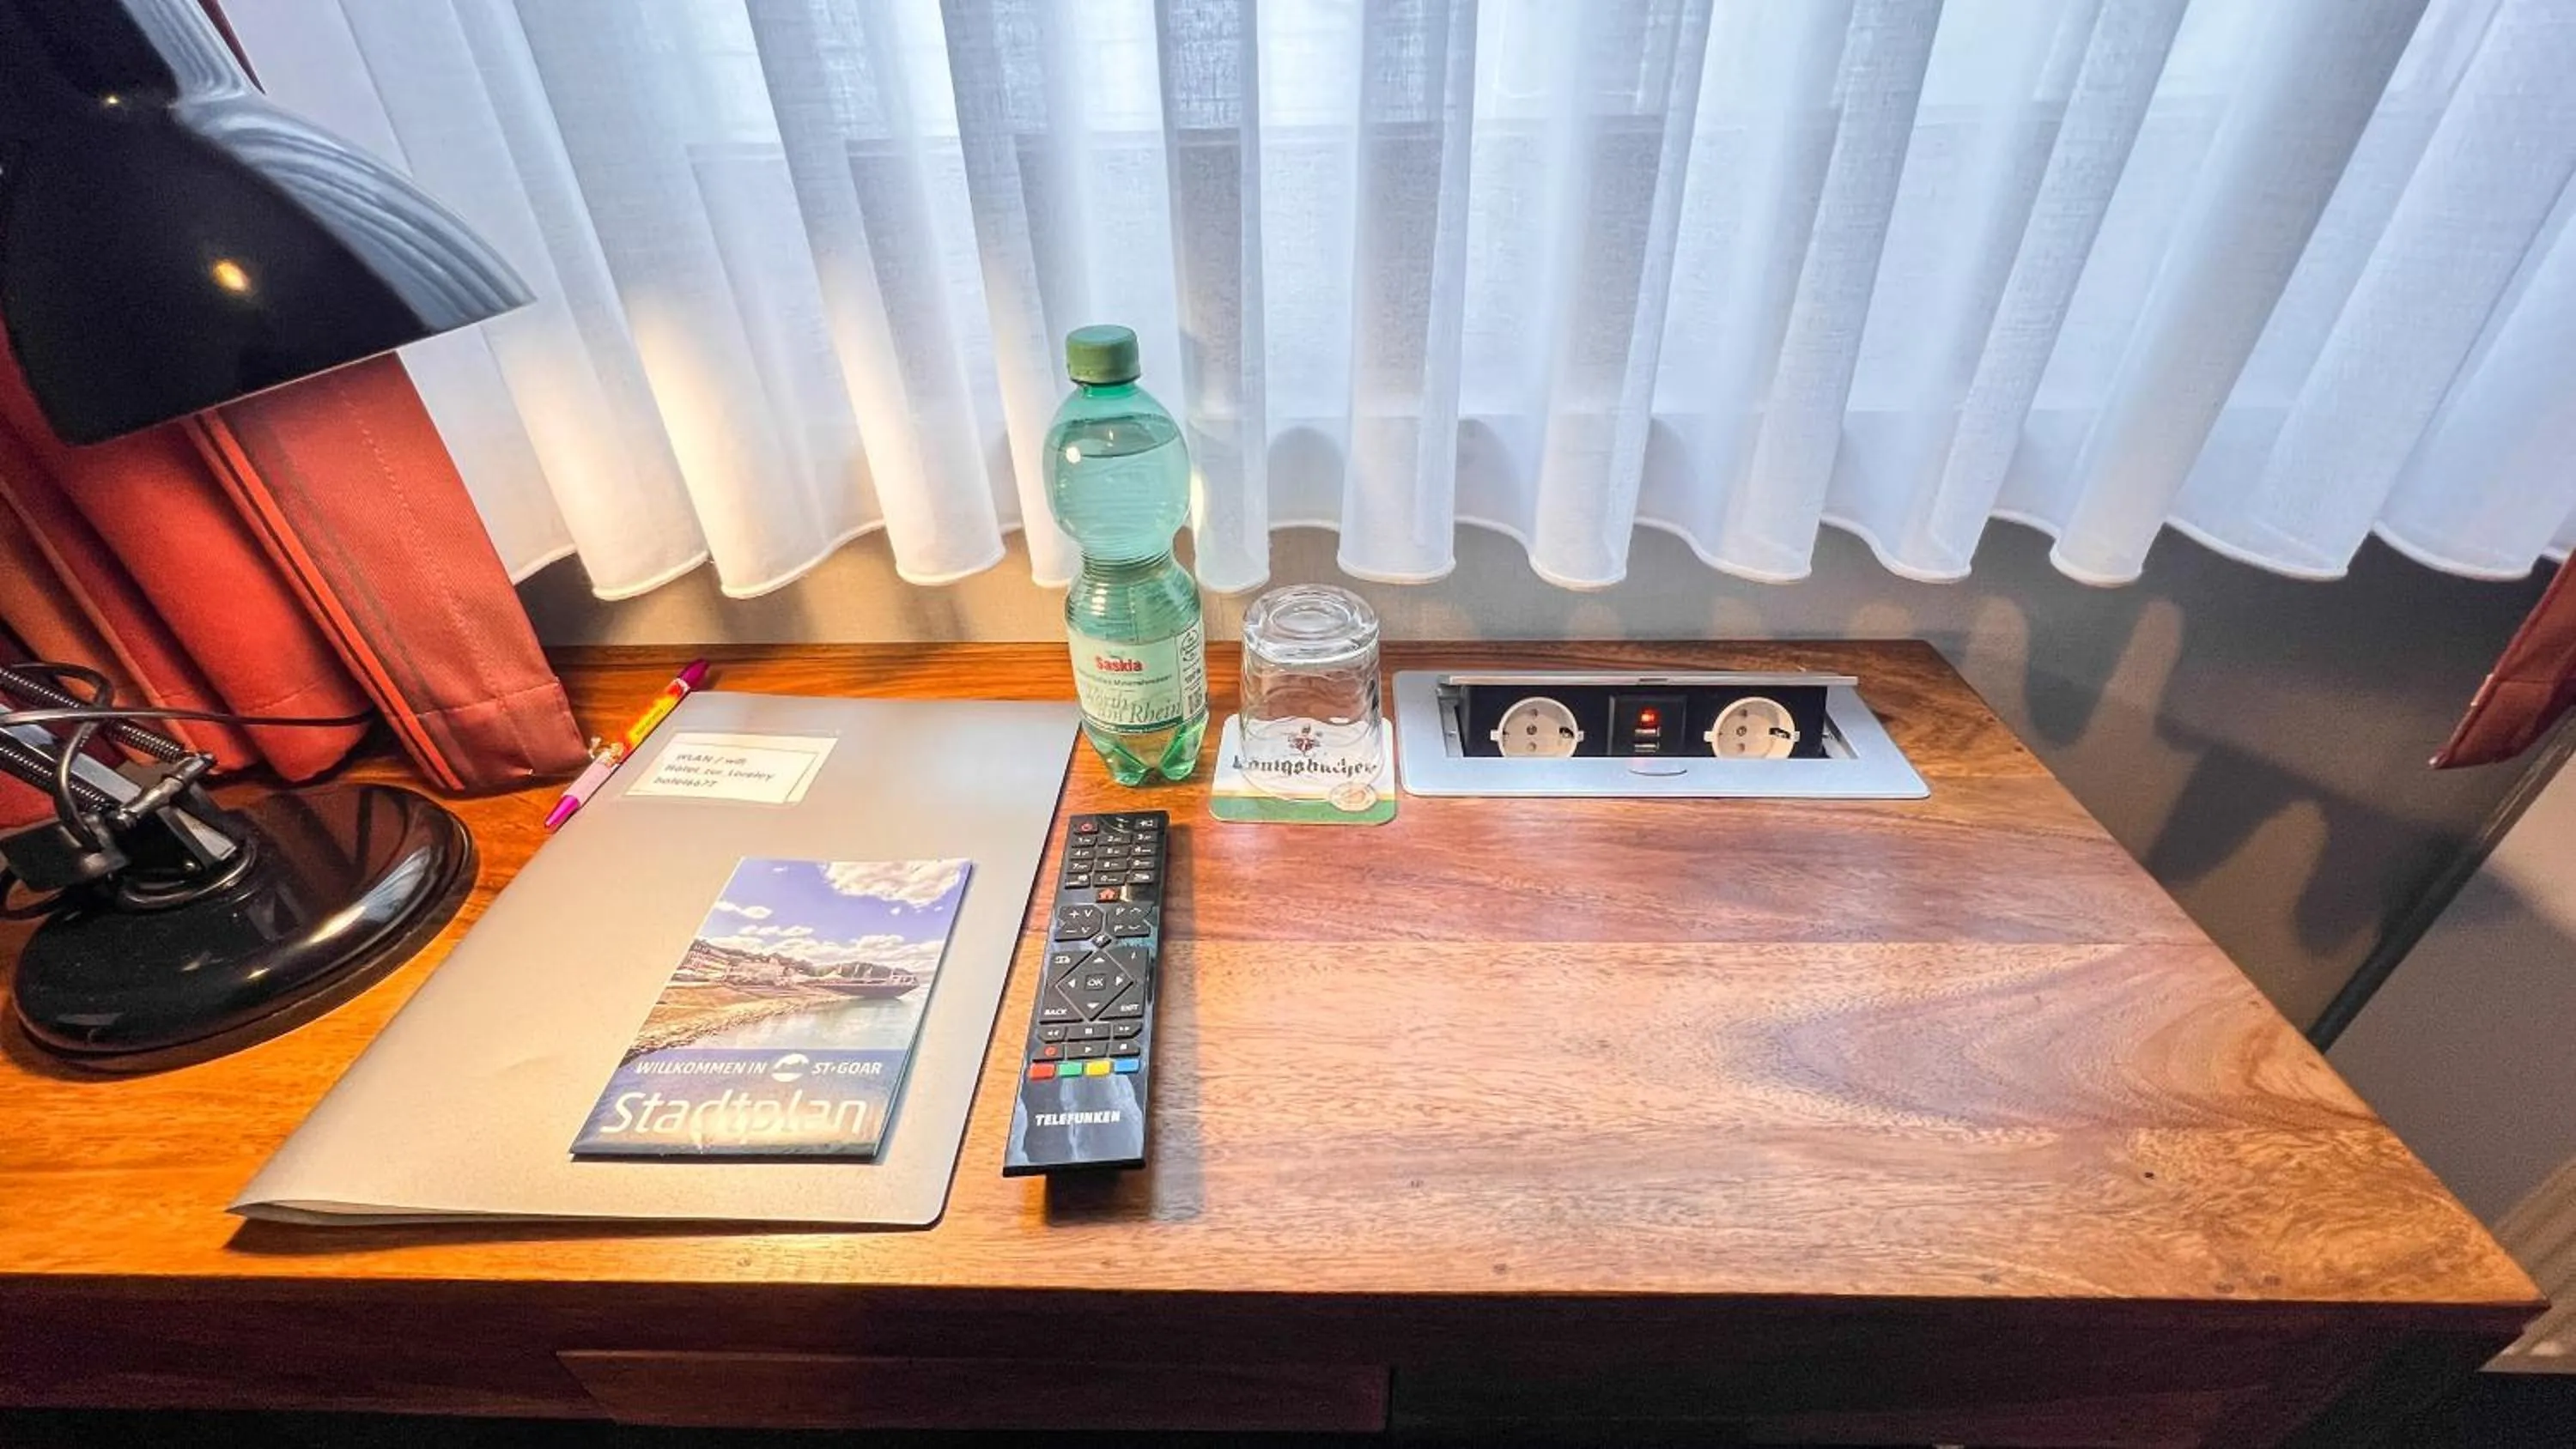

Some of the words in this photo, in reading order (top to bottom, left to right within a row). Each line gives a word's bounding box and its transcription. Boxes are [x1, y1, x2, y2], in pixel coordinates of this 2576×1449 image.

[1095, 656, 1143, 672] Saskia
[1129, 700, 1182, 723] Rhein
[677, 754, 714, 763] WLAN
[664, 763, 700, 773] Hotel
[1086, 978, 1104, 986] OK
[1120, 1003, 1139, 1012] EXIT
[635, 1061, 747, 1075] WILLKOMMEN
[746, 1061, 769, 1074] IN
[600, 1088, 868, 1144] Stadtplan
[1035, 1110, 1121, 1127] TELEFUNKEN
